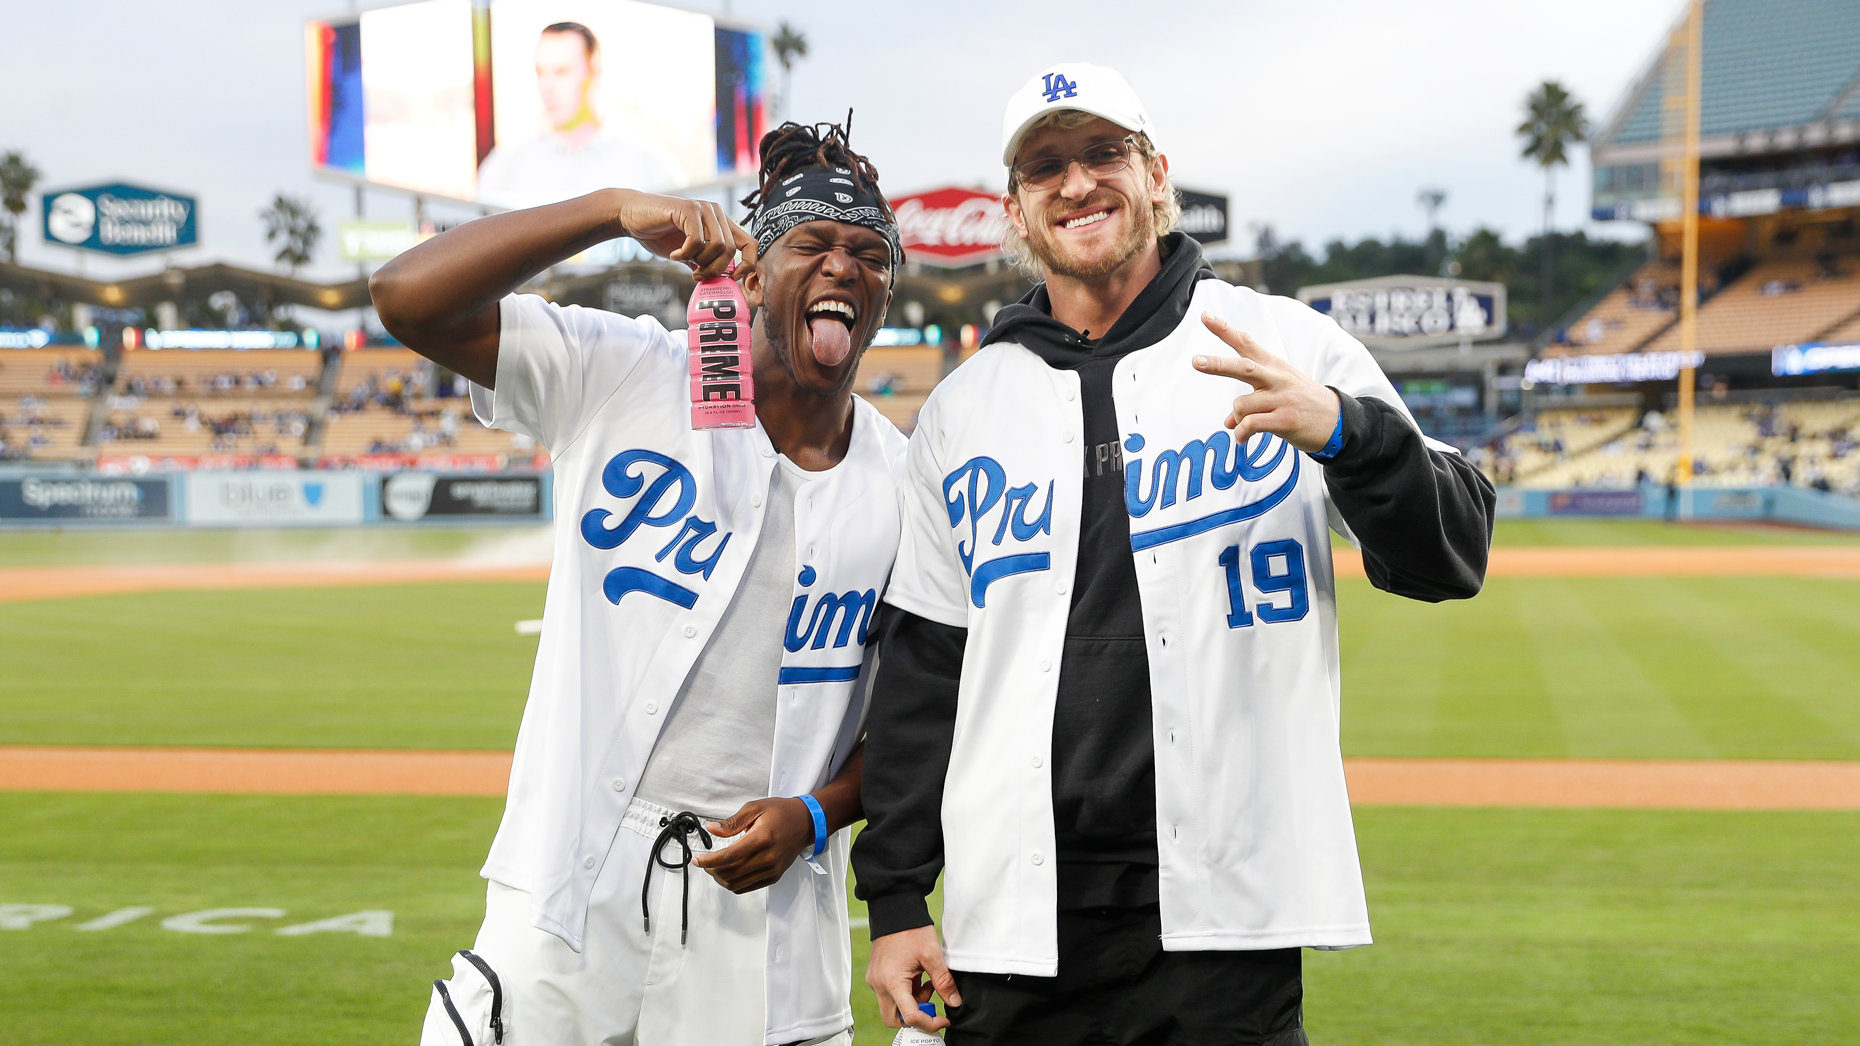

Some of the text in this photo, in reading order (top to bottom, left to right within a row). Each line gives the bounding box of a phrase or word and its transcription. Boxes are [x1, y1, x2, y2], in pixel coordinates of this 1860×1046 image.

[1042, 73, 1077, 102] LA
[97, 193, 190, 229] Security
[99, 216, 177, 246] Benefit
[698, 299, 742, 402] PRIME
[783, 565, 877, 653] im
[1218, 538, 1310, 629] 19
